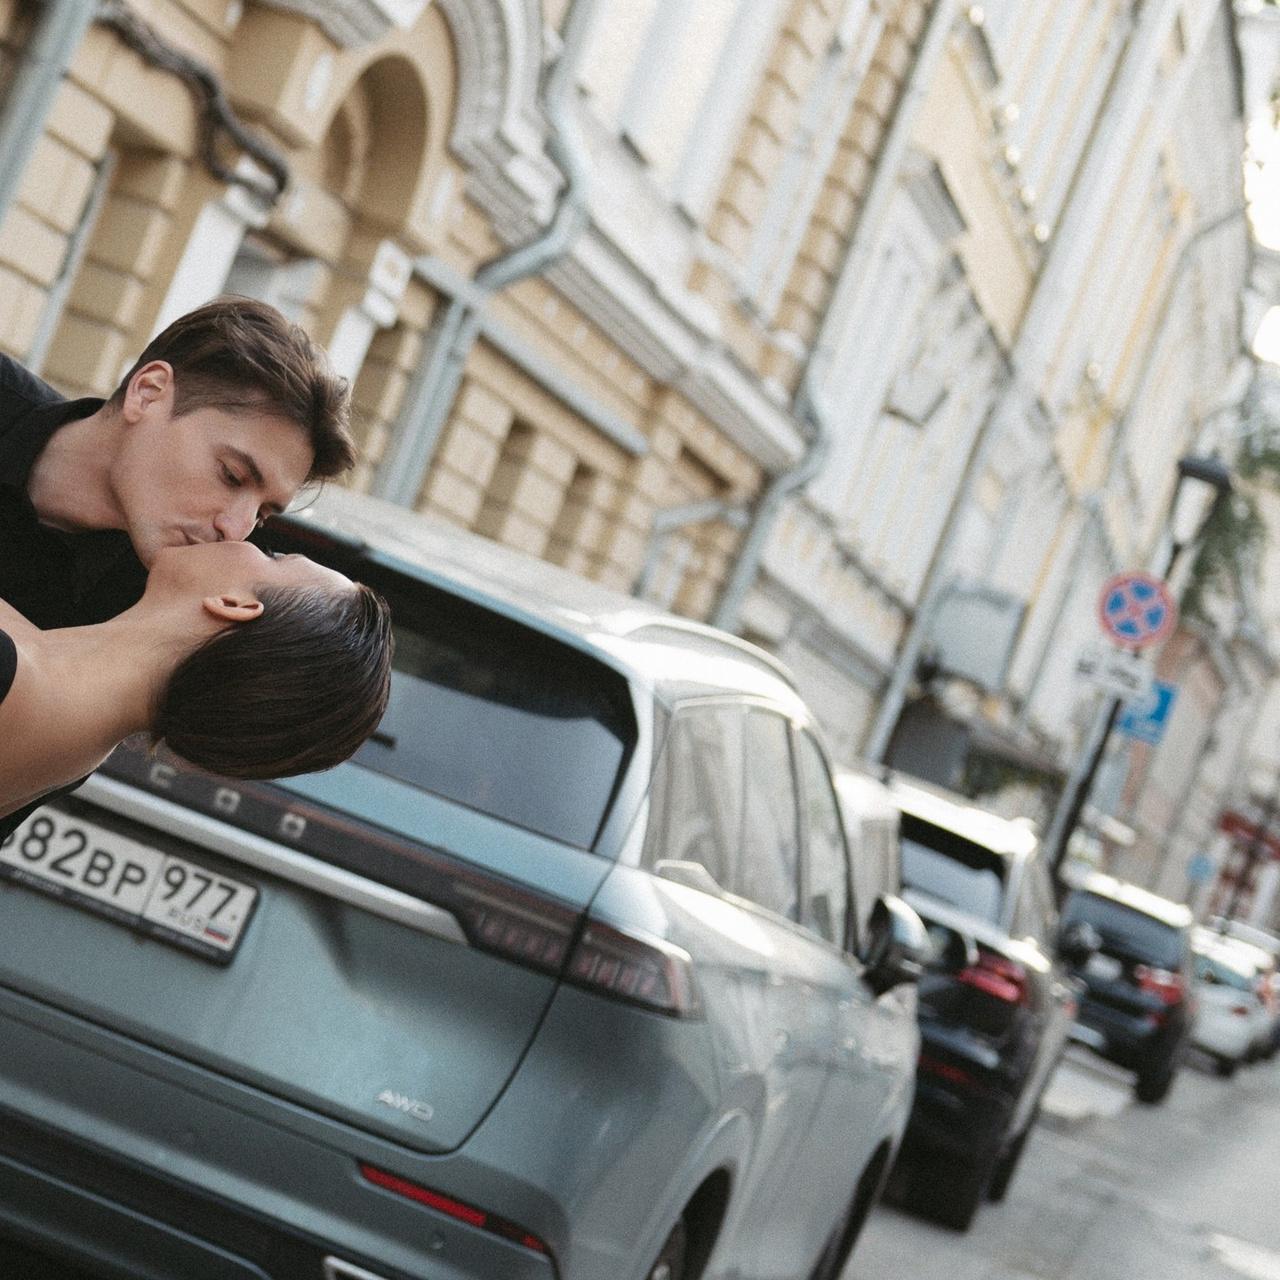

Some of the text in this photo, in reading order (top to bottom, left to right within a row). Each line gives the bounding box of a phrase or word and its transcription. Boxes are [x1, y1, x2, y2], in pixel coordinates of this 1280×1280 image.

[162, 865, 238, 920] 977
[168, 907, 204, 931] RUS
[375, 1089, 434, 1121] AWD
